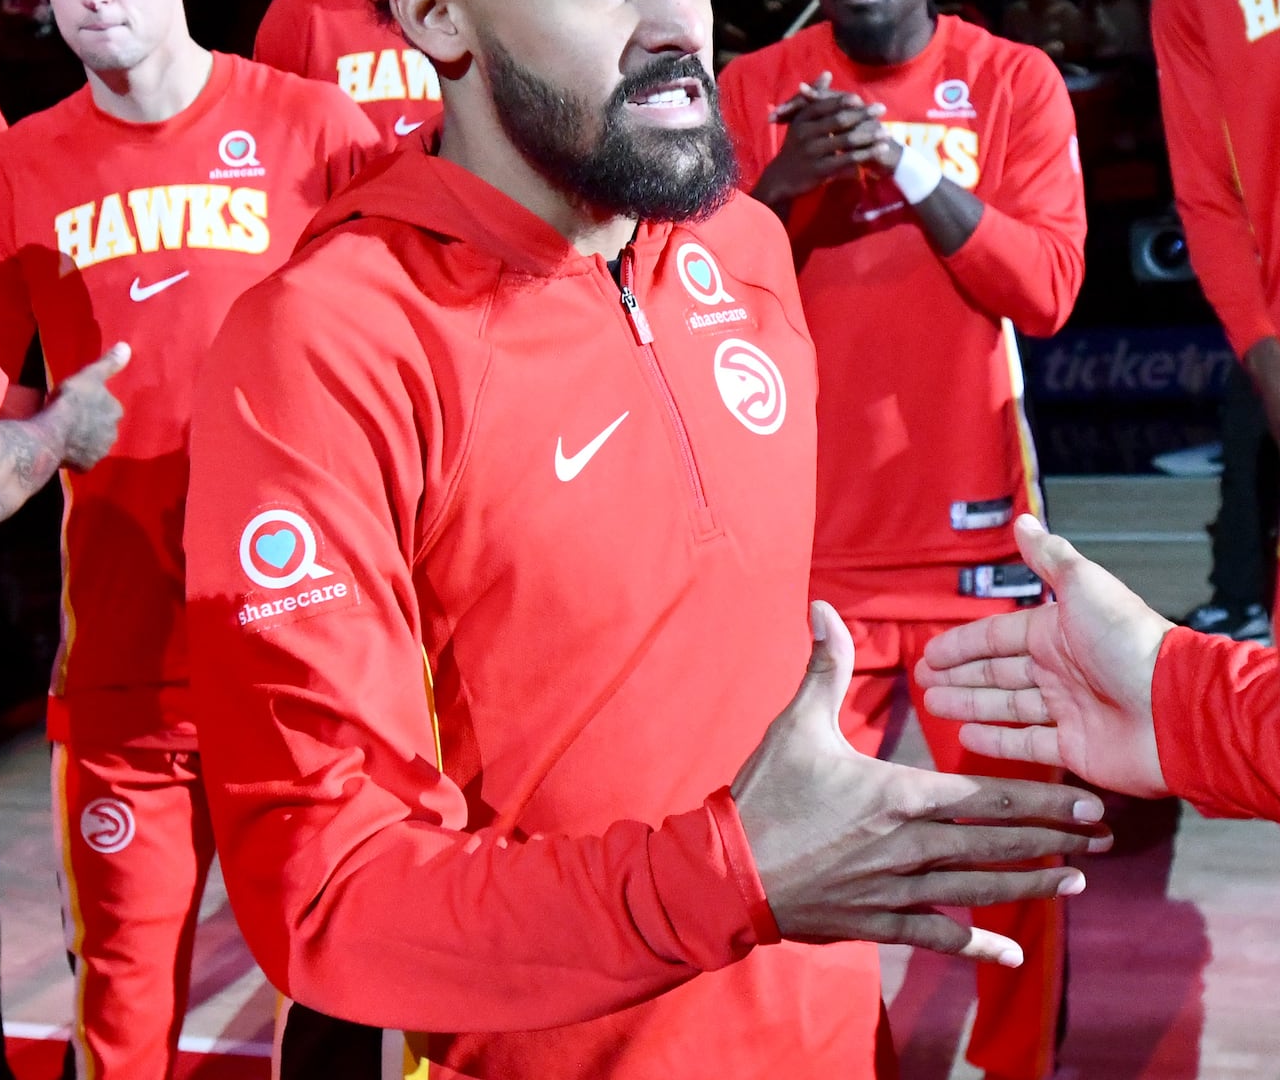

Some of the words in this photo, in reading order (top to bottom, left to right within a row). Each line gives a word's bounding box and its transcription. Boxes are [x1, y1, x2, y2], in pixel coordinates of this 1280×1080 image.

[209, 167, 267, 180] sharecare
[54, 183, 270, 279] HAWKS
[689, 307, 748, 329] sharecare
[238, 582, 348, 626] sharecare
